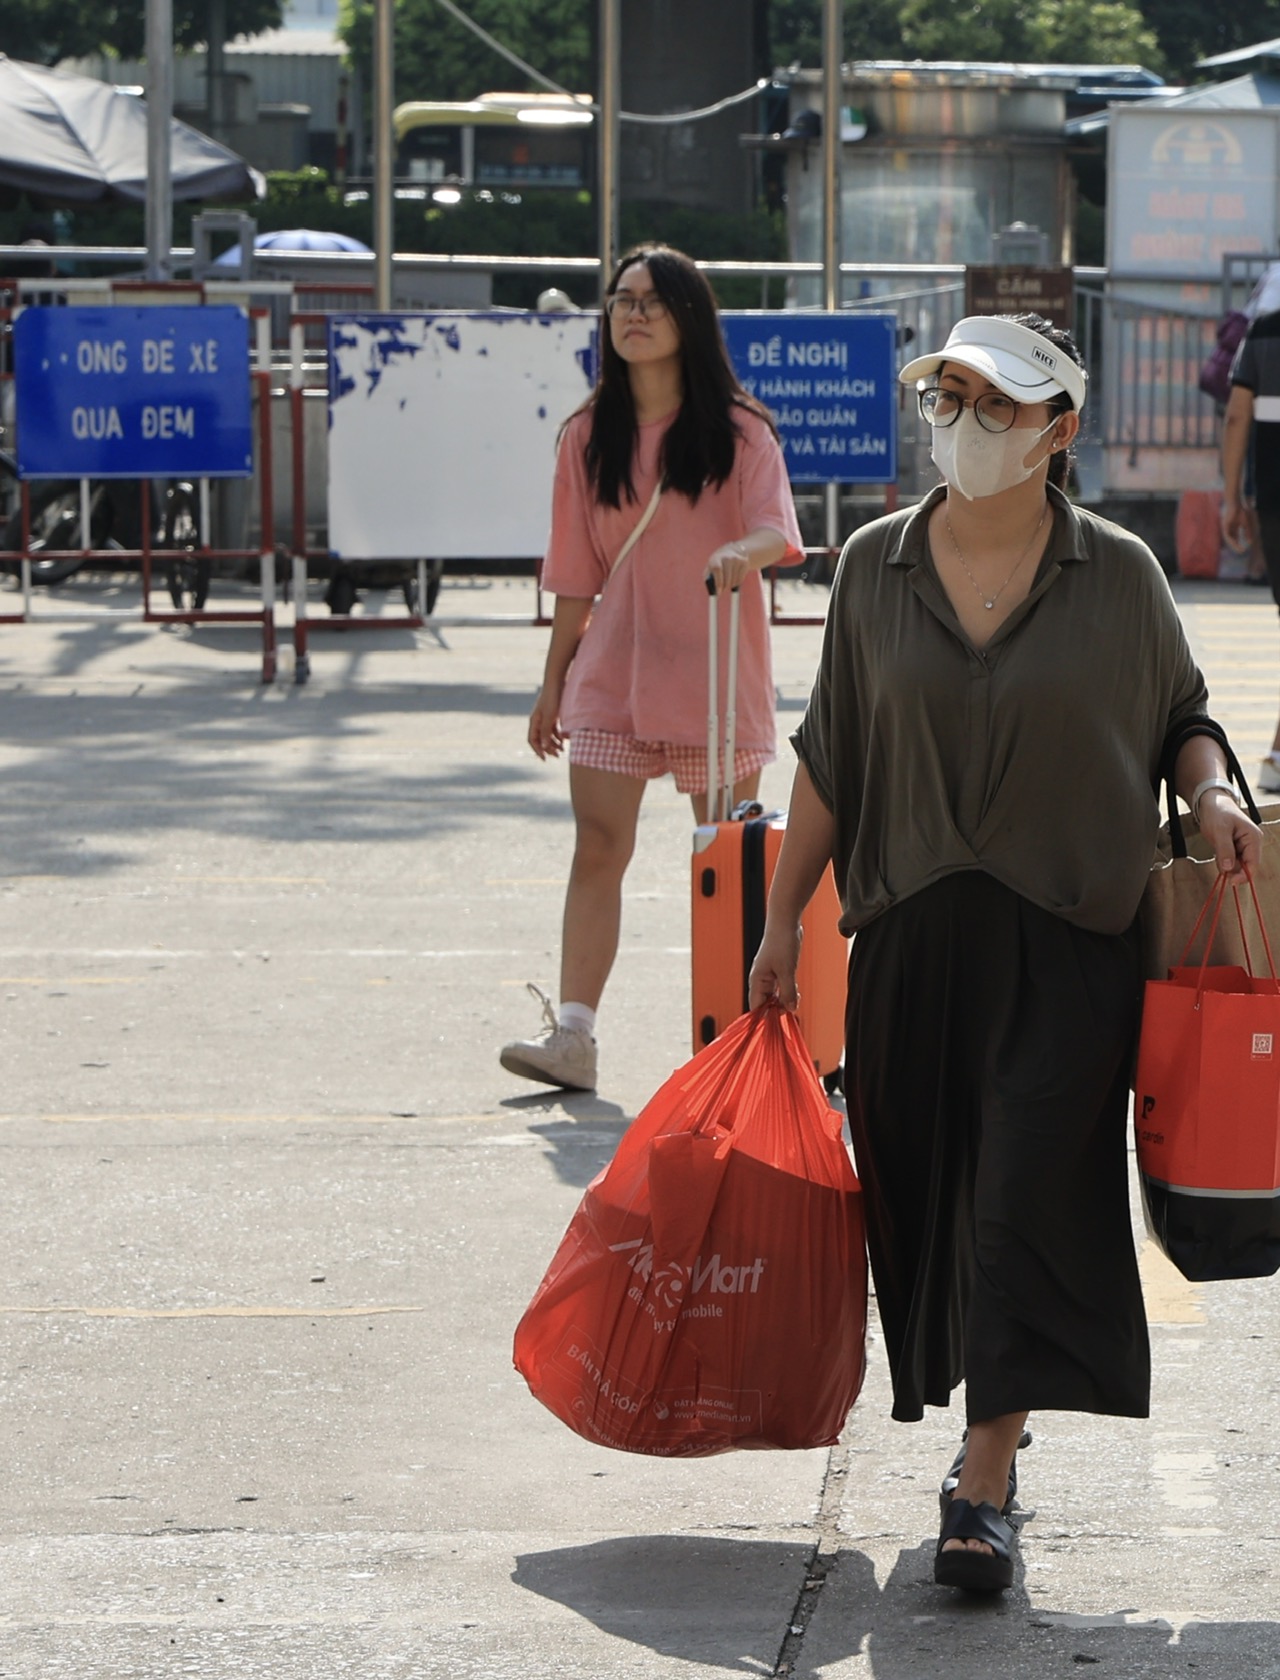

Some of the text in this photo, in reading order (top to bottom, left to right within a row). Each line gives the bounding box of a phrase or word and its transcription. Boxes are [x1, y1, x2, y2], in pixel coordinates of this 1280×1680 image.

[787, 342, 848, 371] NGHỊ
[1034, 349, 1054, 368] NICE
[761, 375, 811, 398] HÀNH
[814, 375, 876, 398] KHÁCH
[72, 405, 124, 439] QUA
[806, 403, 857, 427] QUẢN
[791, 433, 815, 456] VÀ
[817, 433, 846, 456] TÀI
[848, 432, 887, 456] SẢN
[682, 1304, 723, 1320] mobile
